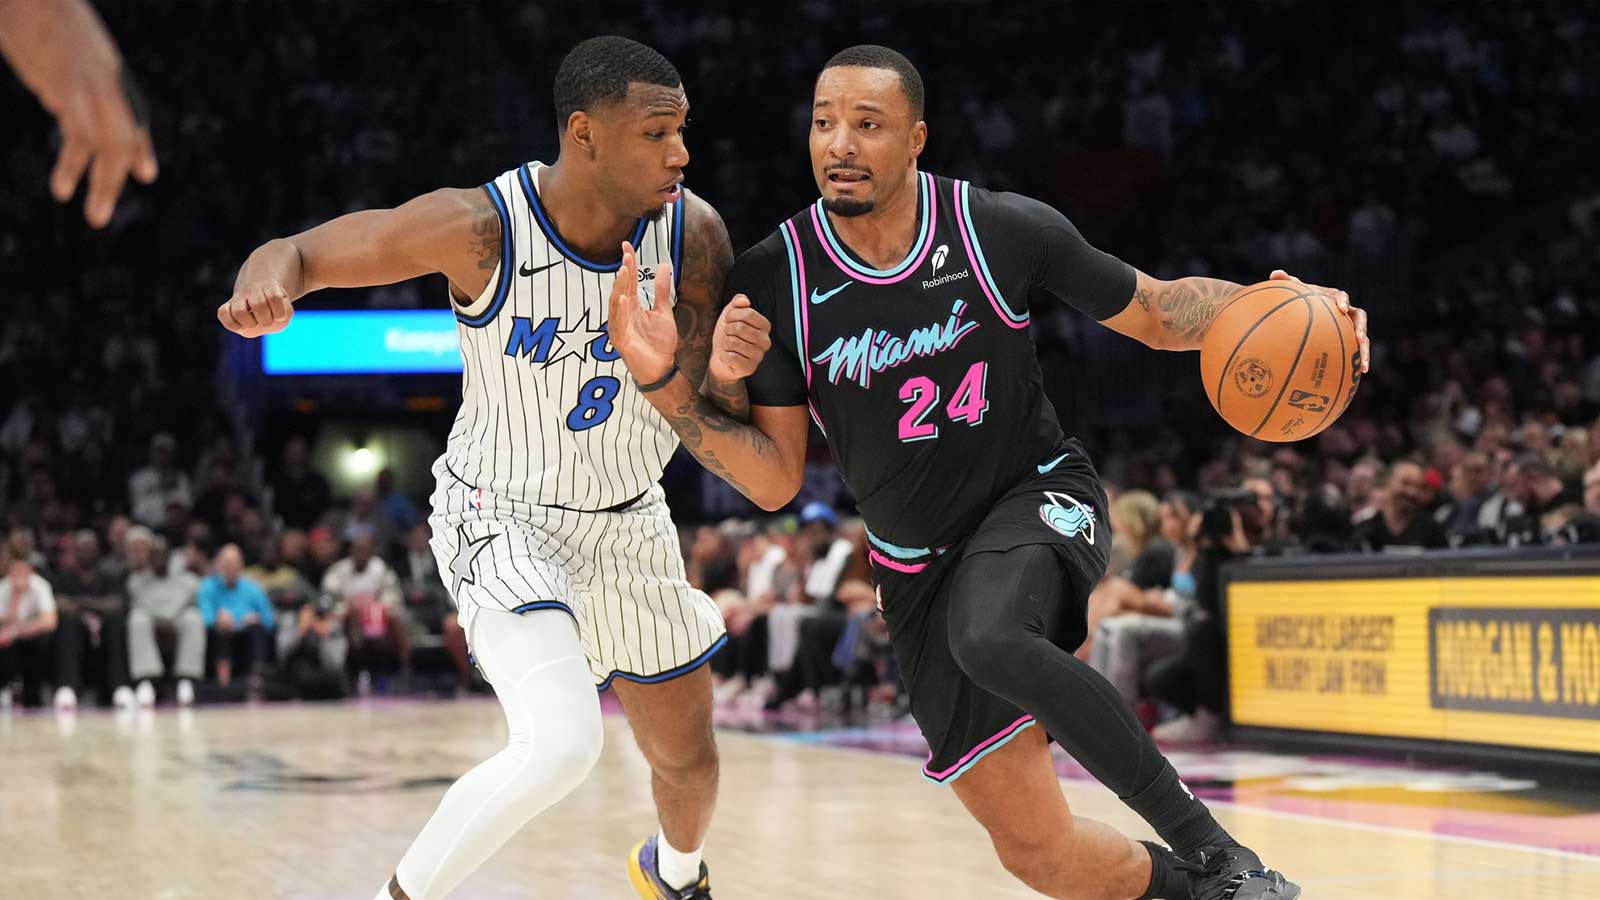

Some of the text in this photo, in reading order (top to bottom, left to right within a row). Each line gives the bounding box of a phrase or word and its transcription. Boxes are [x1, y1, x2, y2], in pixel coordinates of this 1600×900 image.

[922, 269, 969, 290] Robinhood
[812, 298, 981, 389] Miami
[566, 375, 621, 432] 8
[898, 360, 990, 443] 24
[1436, 620, 1534, 702] MORGAN
